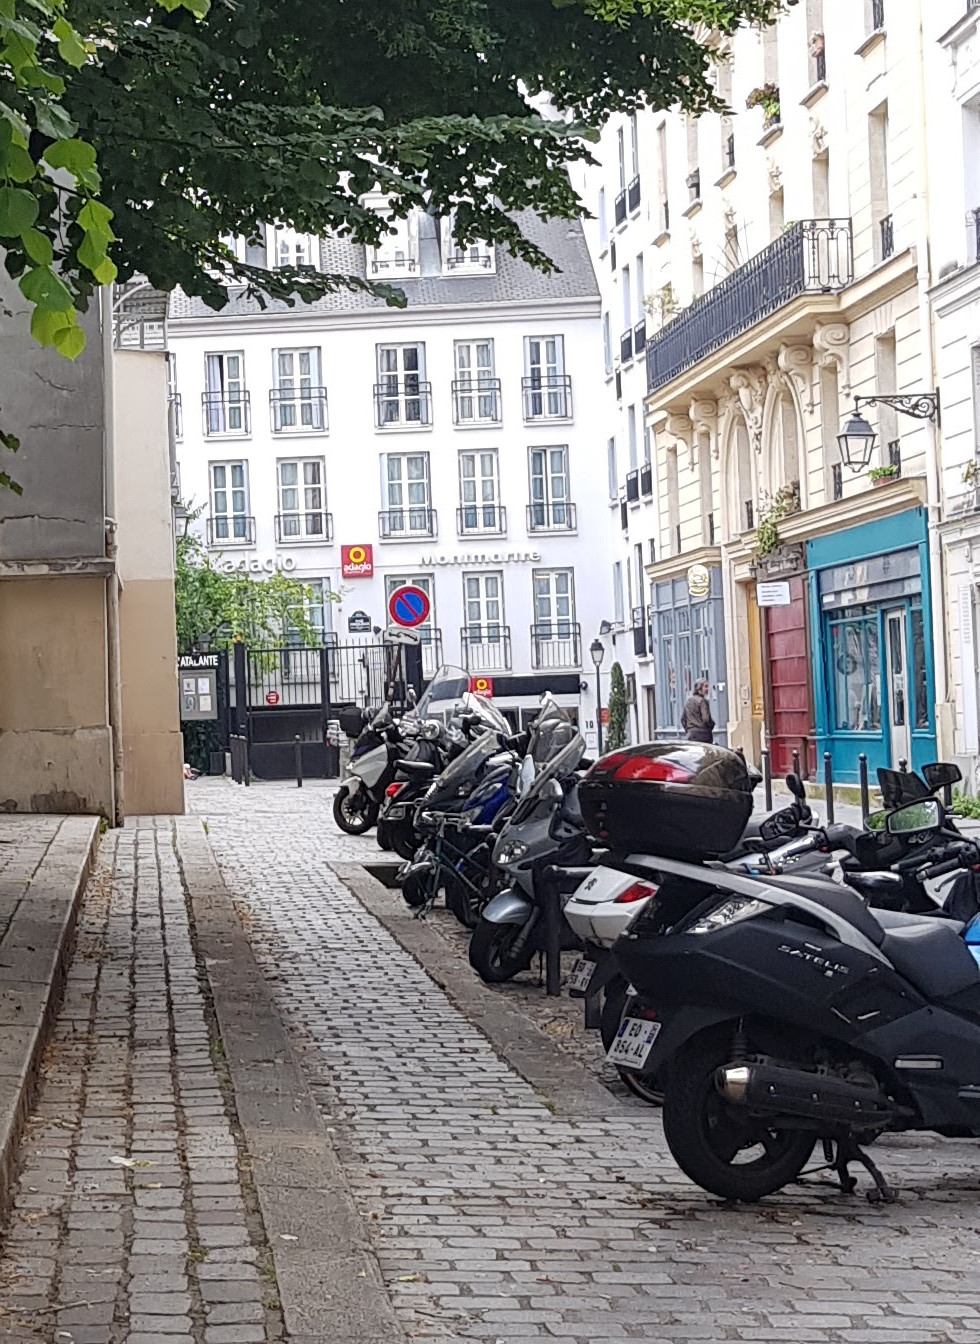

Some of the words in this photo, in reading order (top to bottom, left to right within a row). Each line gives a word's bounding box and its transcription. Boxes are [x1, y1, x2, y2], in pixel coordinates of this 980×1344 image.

[222, 550, 296, 575] adagio
[177, 654, 218, 667] 'ATALANTE
[585, 720, 594, 729] 10
